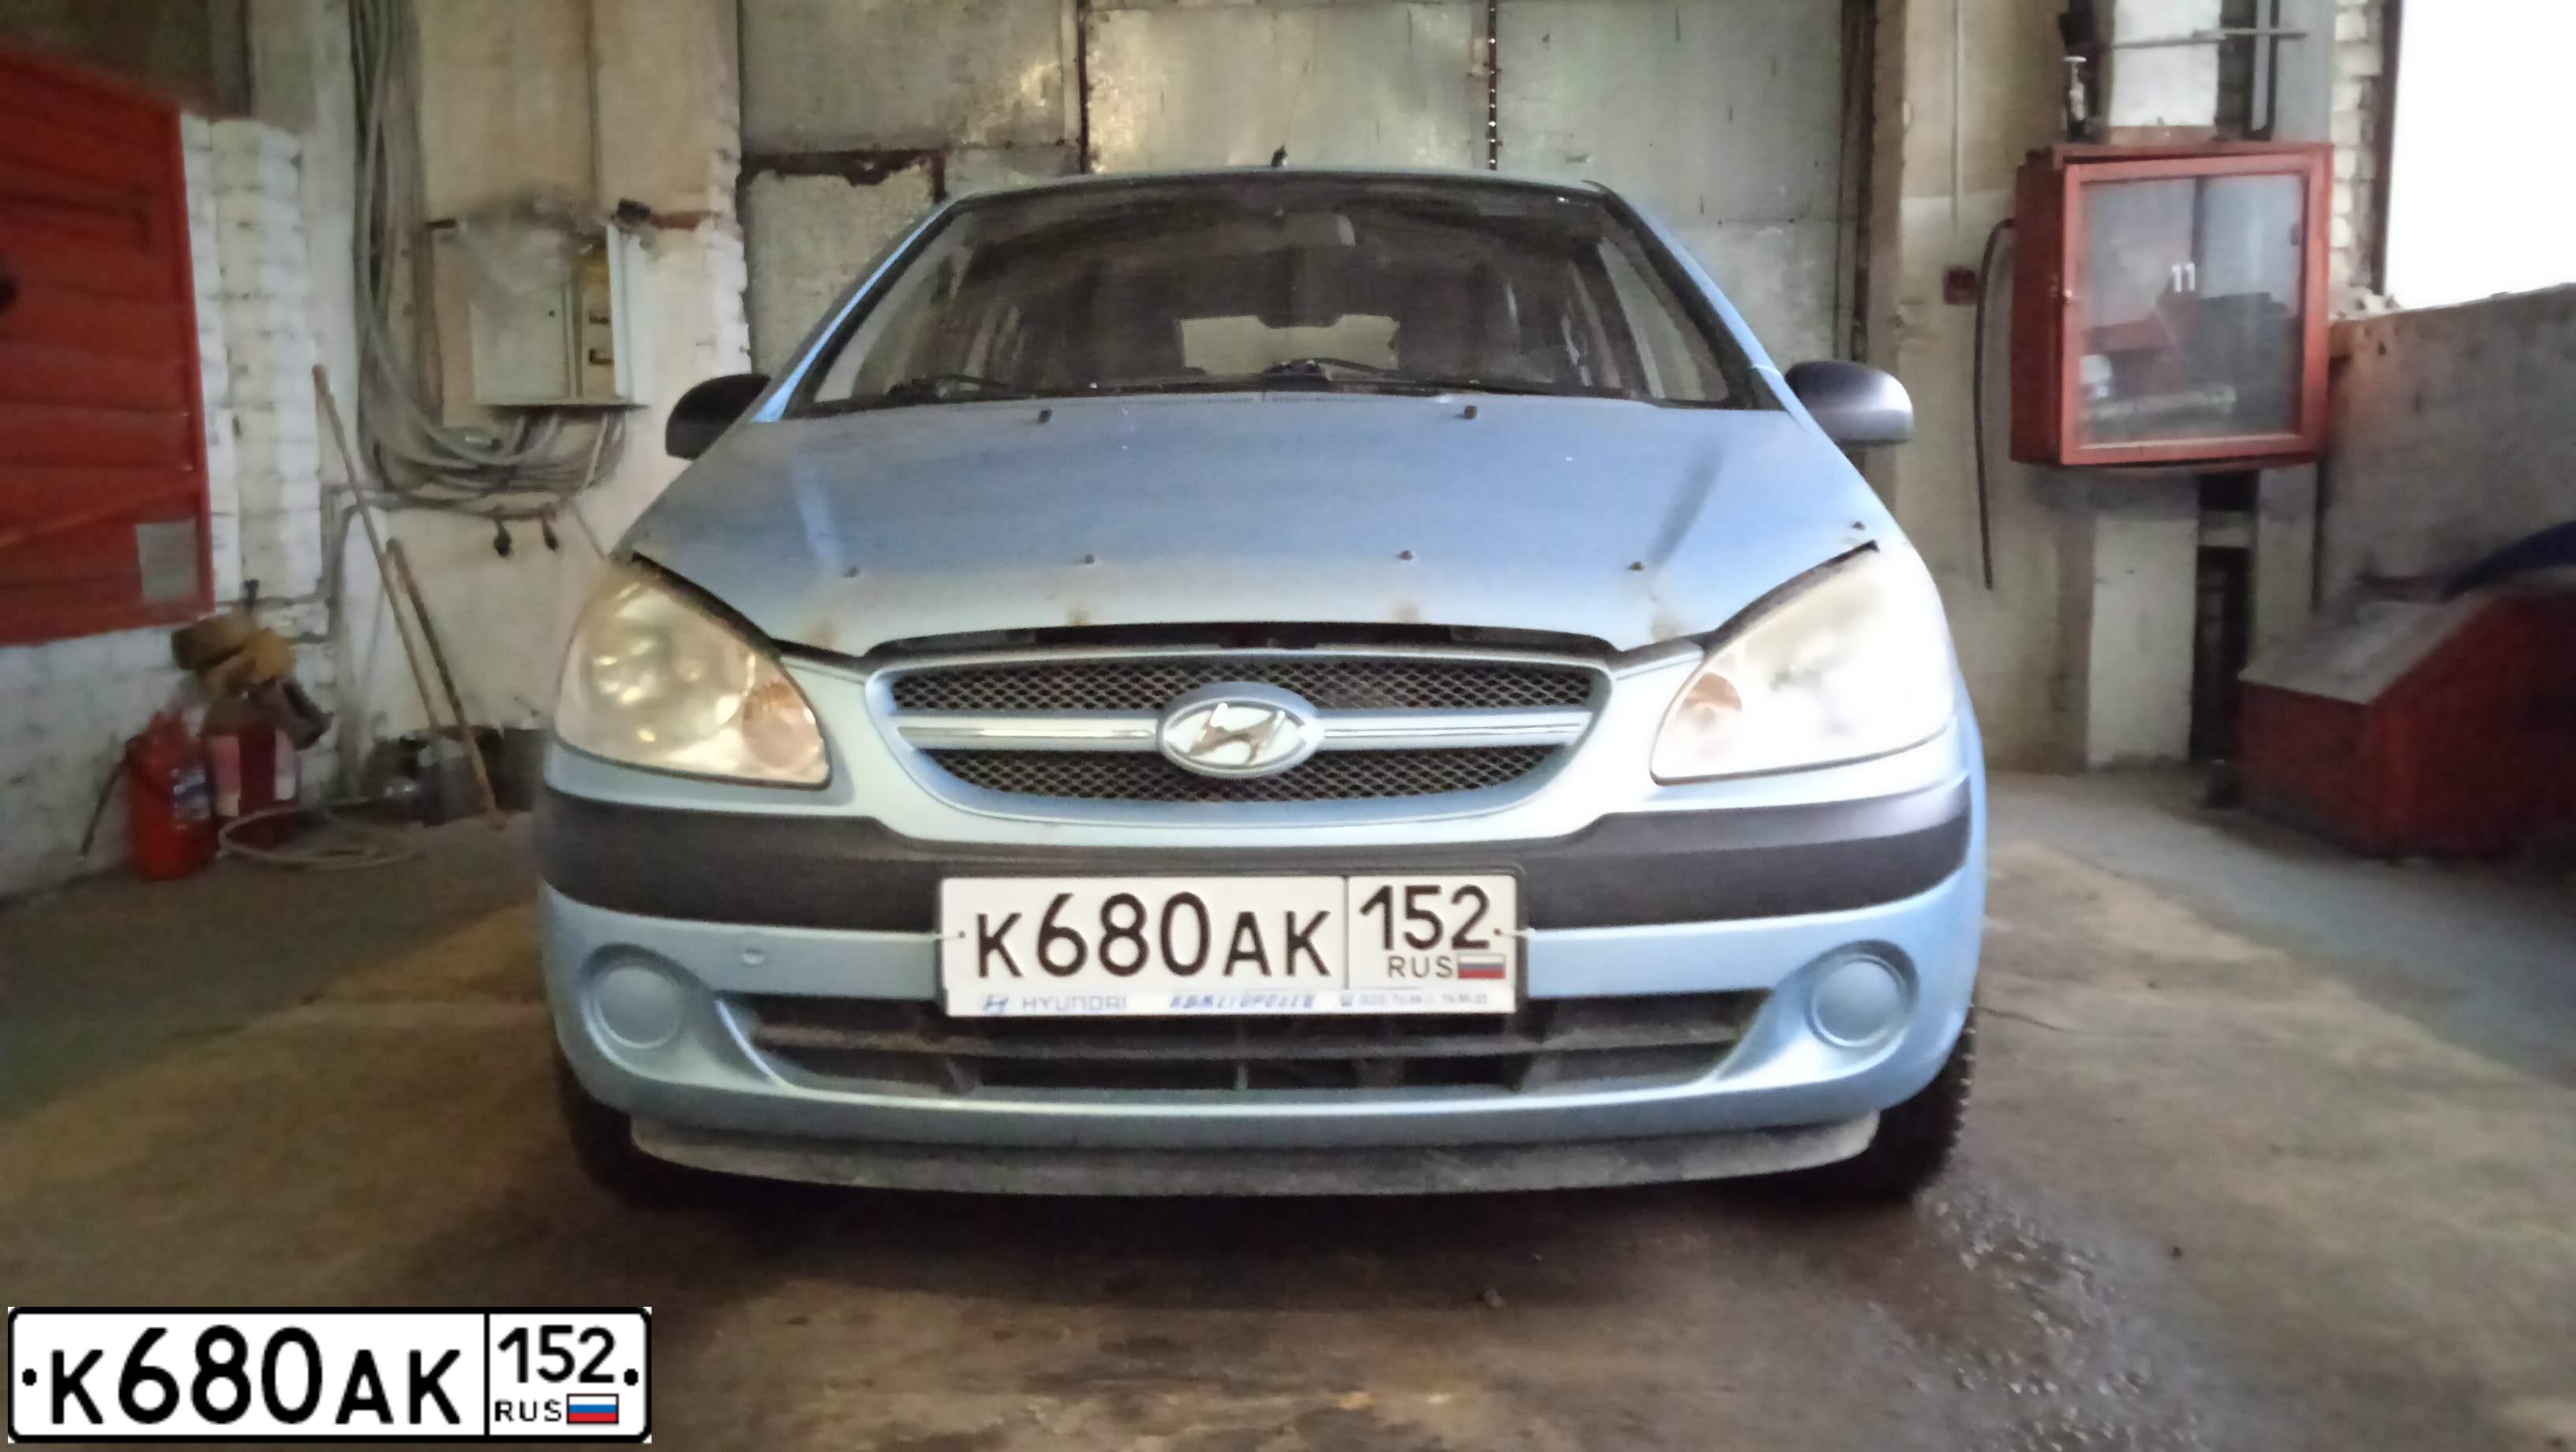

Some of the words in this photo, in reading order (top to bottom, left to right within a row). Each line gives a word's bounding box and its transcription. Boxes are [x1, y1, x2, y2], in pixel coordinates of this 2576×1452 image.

[2172, 264, 2196, 292] 11
[976, 892, 1330, 978] К680АК
[1359, 885, 1490, 951] 152
[1387, 955, 1453, 979] RUS
[1022, 996, 1127, 1012] HYUNDAI
